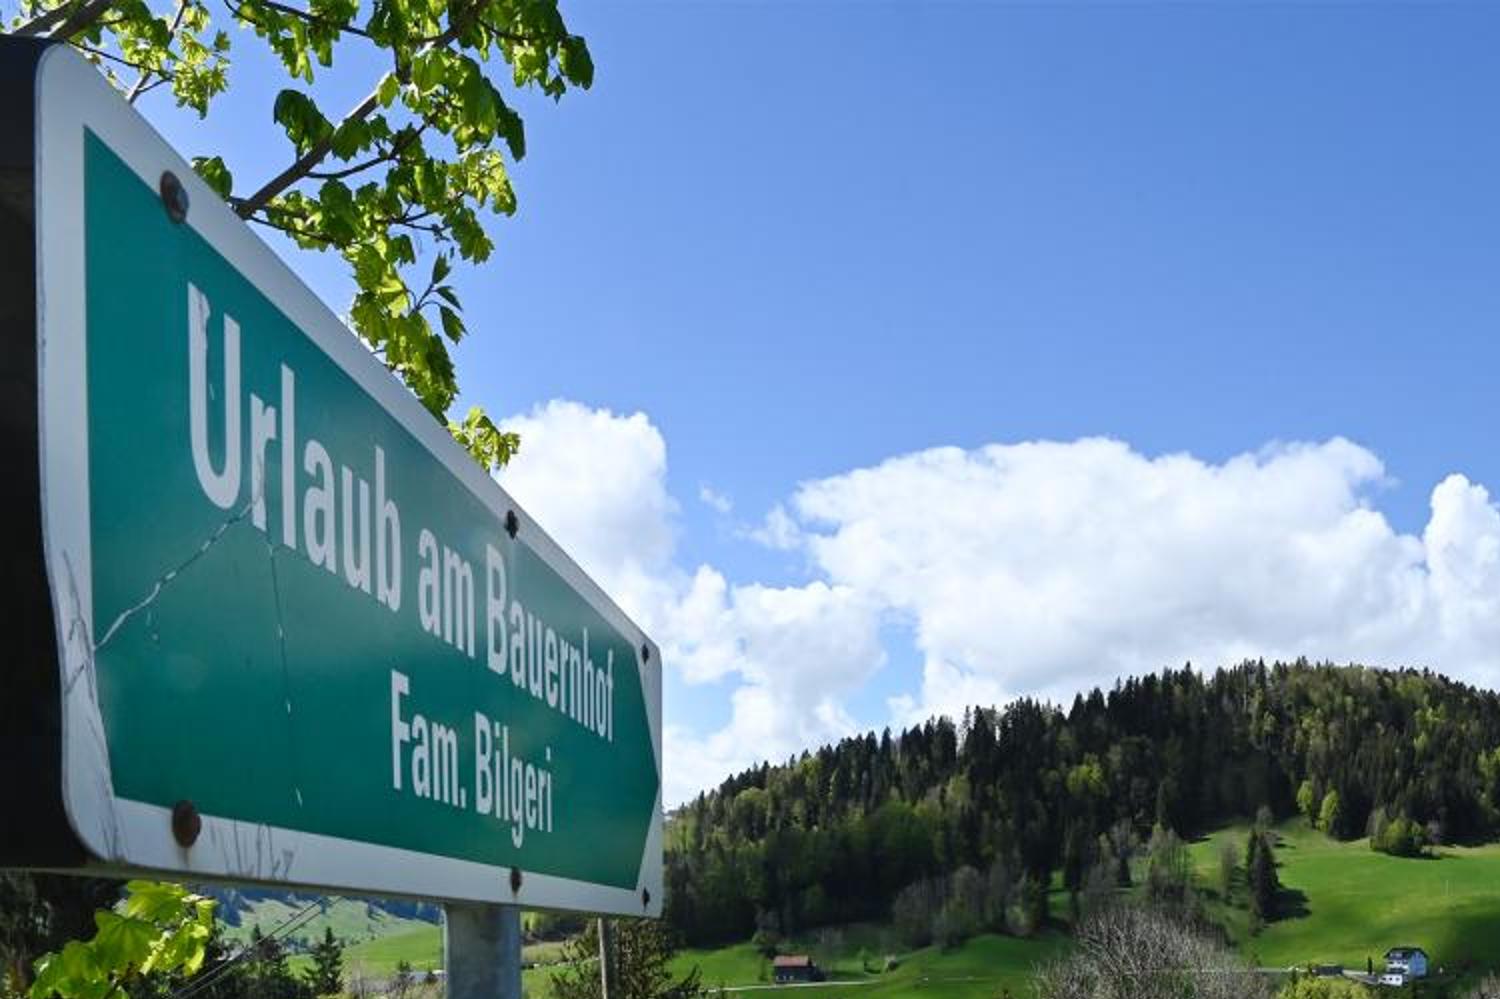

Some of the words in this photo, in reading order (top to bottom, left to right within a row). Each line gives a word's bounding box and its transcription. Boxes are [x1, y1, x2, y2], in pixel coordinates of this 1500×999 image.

[188, 282, 402, 612] Urlaub
[418, 527, 476, 660] am
[486, 543, 614, 743] Bauernhof
[391, 669, 467, 810] Fam.
[474, 711, 553, 848] Bilgeri
